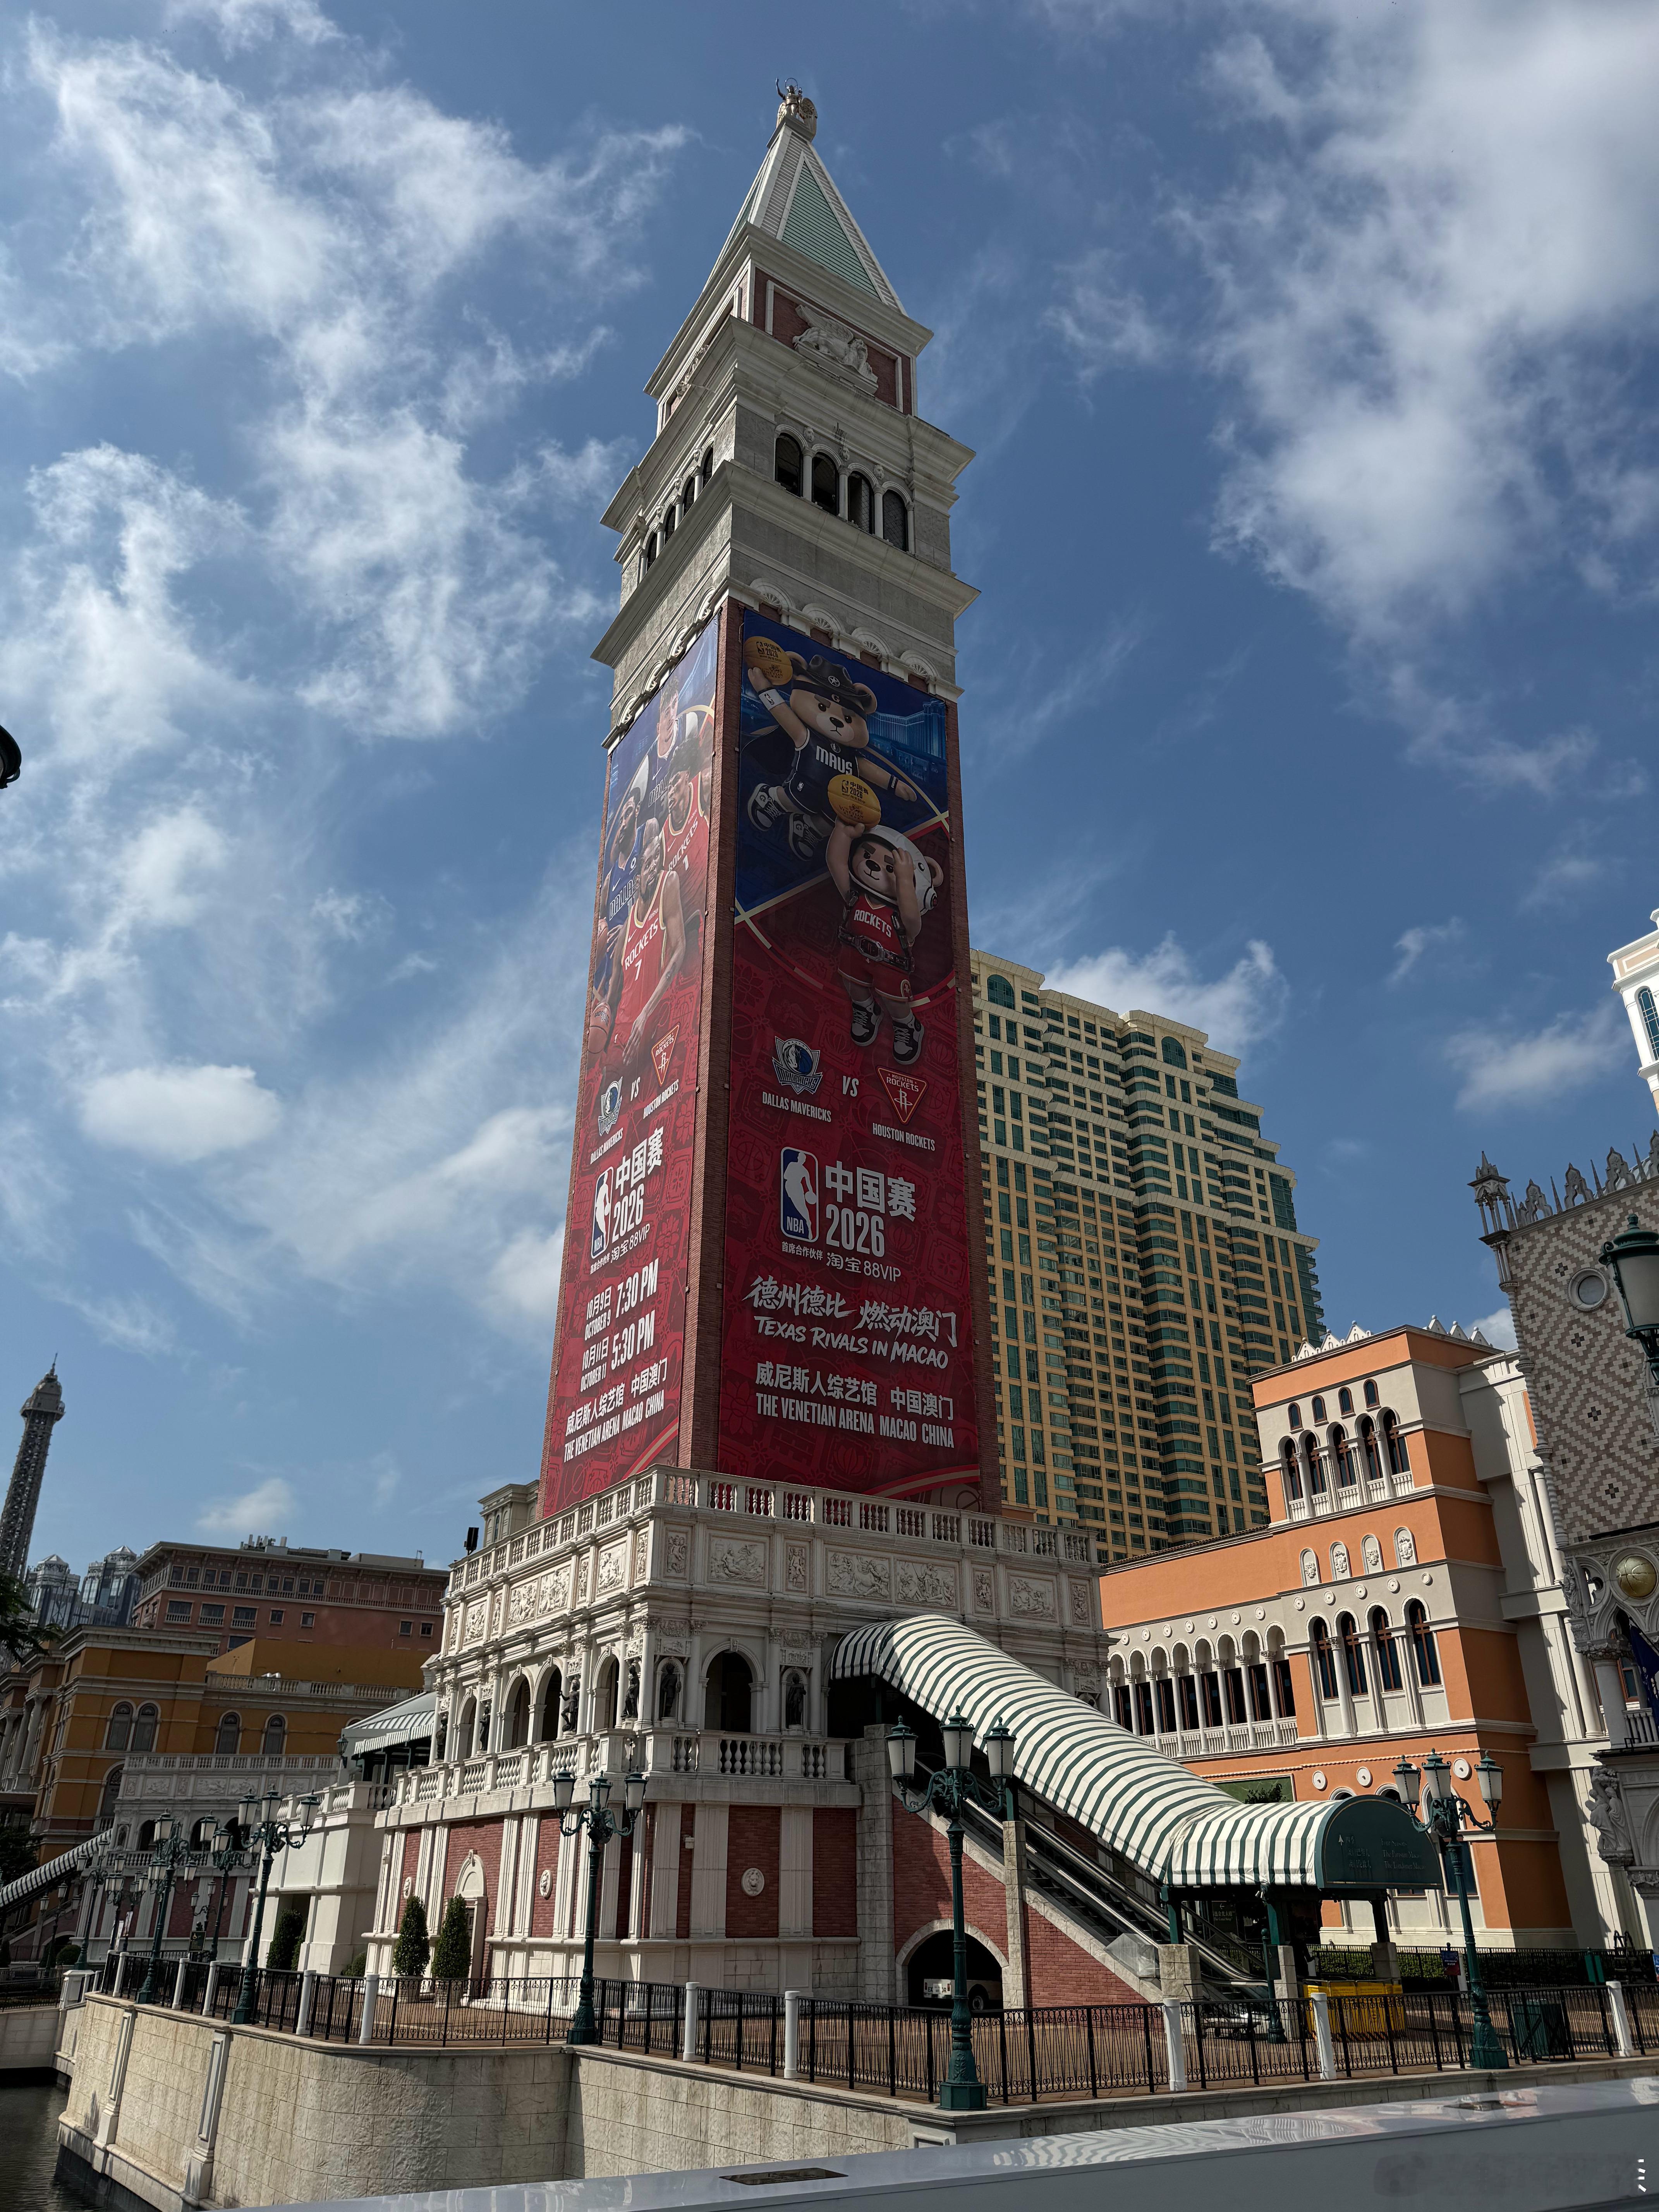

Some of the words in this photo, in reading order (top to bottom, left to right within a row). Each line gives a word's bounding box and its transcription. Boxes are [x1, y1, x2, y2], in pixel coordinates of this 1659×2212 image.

[765, 648, 778, 658] 2026
[850, 787, 863, 799] 2026
[669, 816, 699, 871] ROCKETS
[683, 855, 689, 871] 1
[854, 909, 892, 938] ROCKETS
[624, 917, 658, 970] ROCKETS
[635, 958, 642, 981] 7
[655, 1035, 674, 1057] ROCKETS
[630, 1076, 641, 1101] VS
[842, 1075, 859, 1097] VS
[886, 1077, 919, 1092] ROCKETS
[892, 1073, 913, 1083] HOUSTON
[762, 1092, 789, 1110] DALLAS
[791, 1102, 831, 1123] MAVERICKS
[872, 1123, 904, 1142] HOUSTON
[905, 1129, 935, 1151] ROCKETS
[615, 1126, 664, 1197] 中国赛
[825, 1161, 917, 1222] 中国赛
[611, 1183, 644, 1243] 2026
[787, 1216, 804, 1234] NBA
[593, 1235, 603, 1254] NBA
[826, 1204, 885, 1257] 2026
[782, 1241, 824, 1261] 首席合作伙伴
[586, 1286, 612, 1320] 10月9日
[616, 1272, 639, 1318] 7:30
[640, 1258, 659, 1302] PM
[742, 1275, 857, 1318] 德州德比
[584, 1316, 606, 1341] OCTOBER
[606, 1309, 611, 1327] 9
[611, 1324, 635, 1370] 5:30
[637, 1310, 655, 1355] PM
[852, 1300, 957, 1347] 燃动澳门
[582, 1336, 610, 1371] 10月11日
[754, 1316, 806, 1342] TEXAS
[810, 1327, 868, 1354] RIVALS
[872, 1340, 888, 1356] IN
[890, 1341, 949, 1369] MACAO
[580, 1367, 602, 1392] OCTOBER
[601, 1362, 607, 1379] 11
[631, 1357, 668, 1399] 中国澳门
[755, 1361, 877, 1406] 威尼斯人综艺馆
[565, 1383, 625, 1437] 威尼斯人综艺馆
[756, 1392, 778, 1417] THE
[781, 1396, 836, 1427] VENETIAN
[839, 1407, 875, 1434] ARENA
[879, 1415, 917, 1442] MACAO
[922, 1423, 954, 1448] CHINA
[890, 1387, 953, 1421] 中国澳门
[563, 1441, 574, 1463] THE
[574, 1426, 603, 1457] VENETIAN
[601, 1413, 620, 1444] ARENA
[622, 1400, 643, 1431] MACAO
[645, 1389, 665, 1418] CHINA
